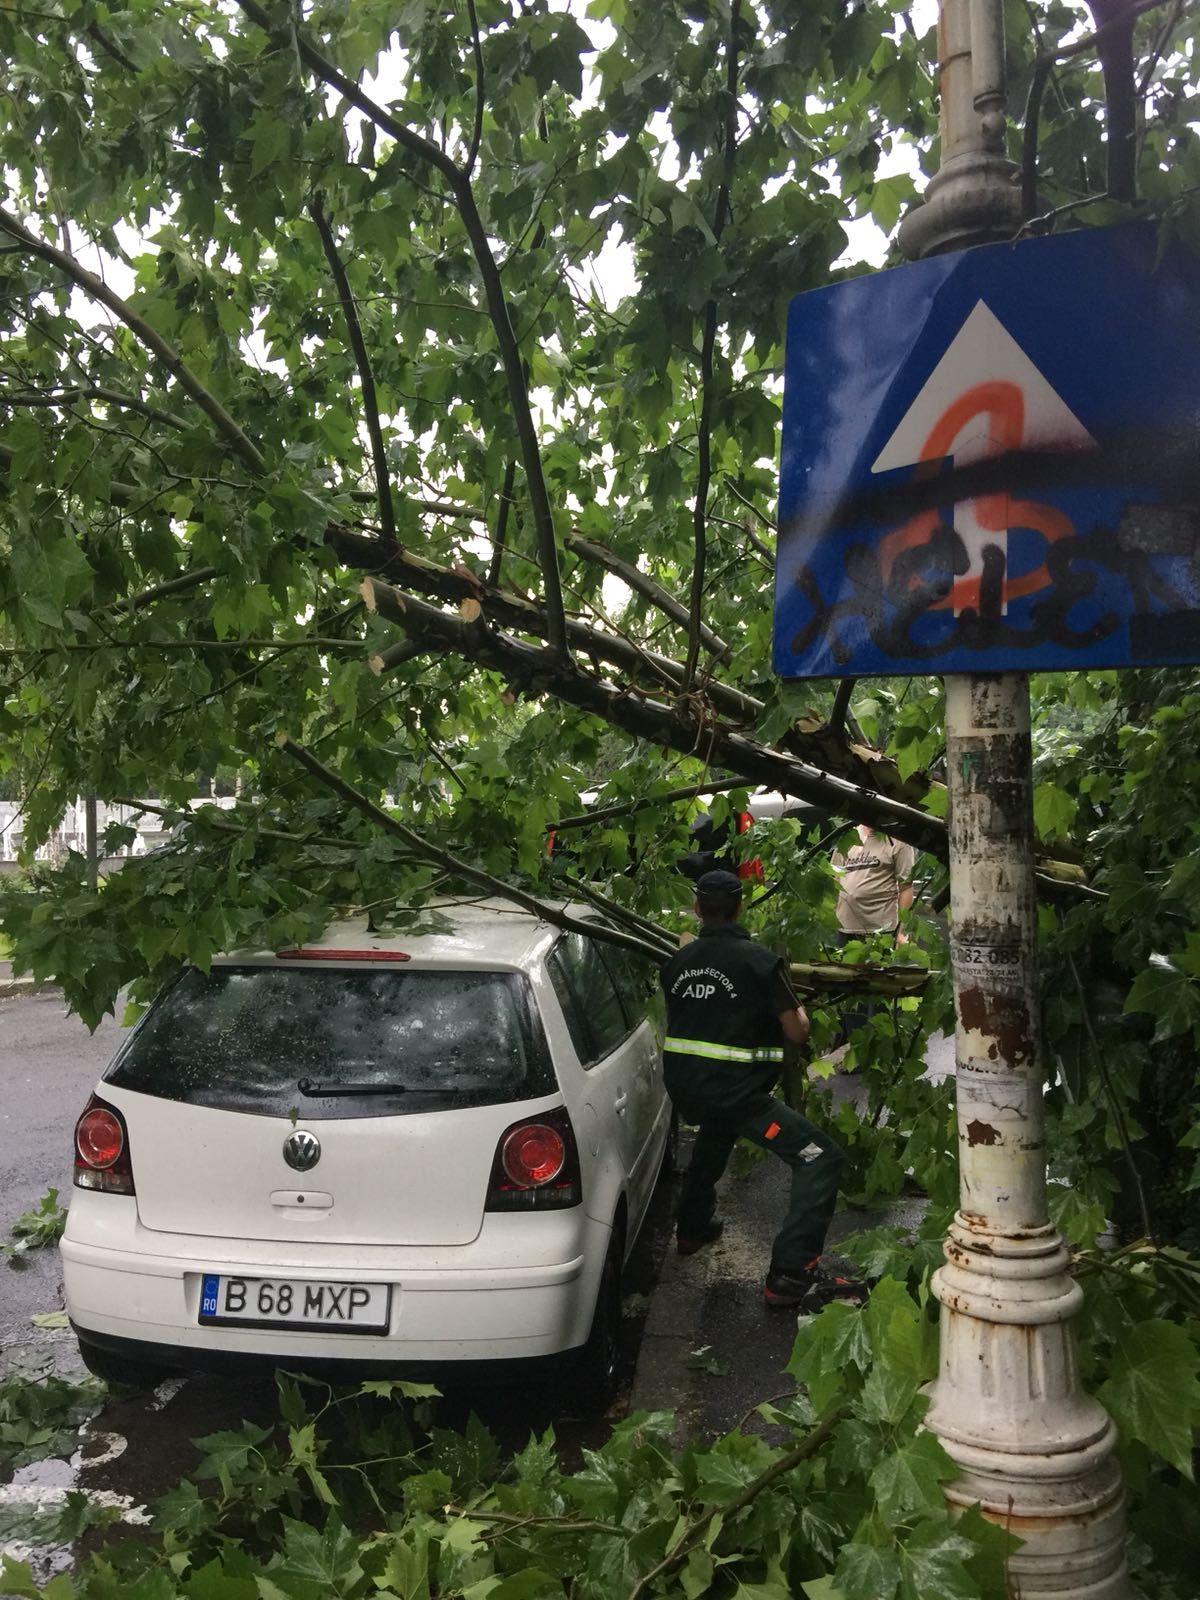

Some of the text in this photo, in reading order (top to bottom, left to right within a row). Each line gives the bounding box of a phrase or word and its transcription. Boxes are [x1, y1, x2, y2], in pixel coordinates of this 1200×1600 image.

[704, 967, 734, 992] SECTOR
[682, 984, 716, 999] ADP
[203, 1298, 216, 1312] RO
[225, 1280, 372, 1320] B 68 MXP
